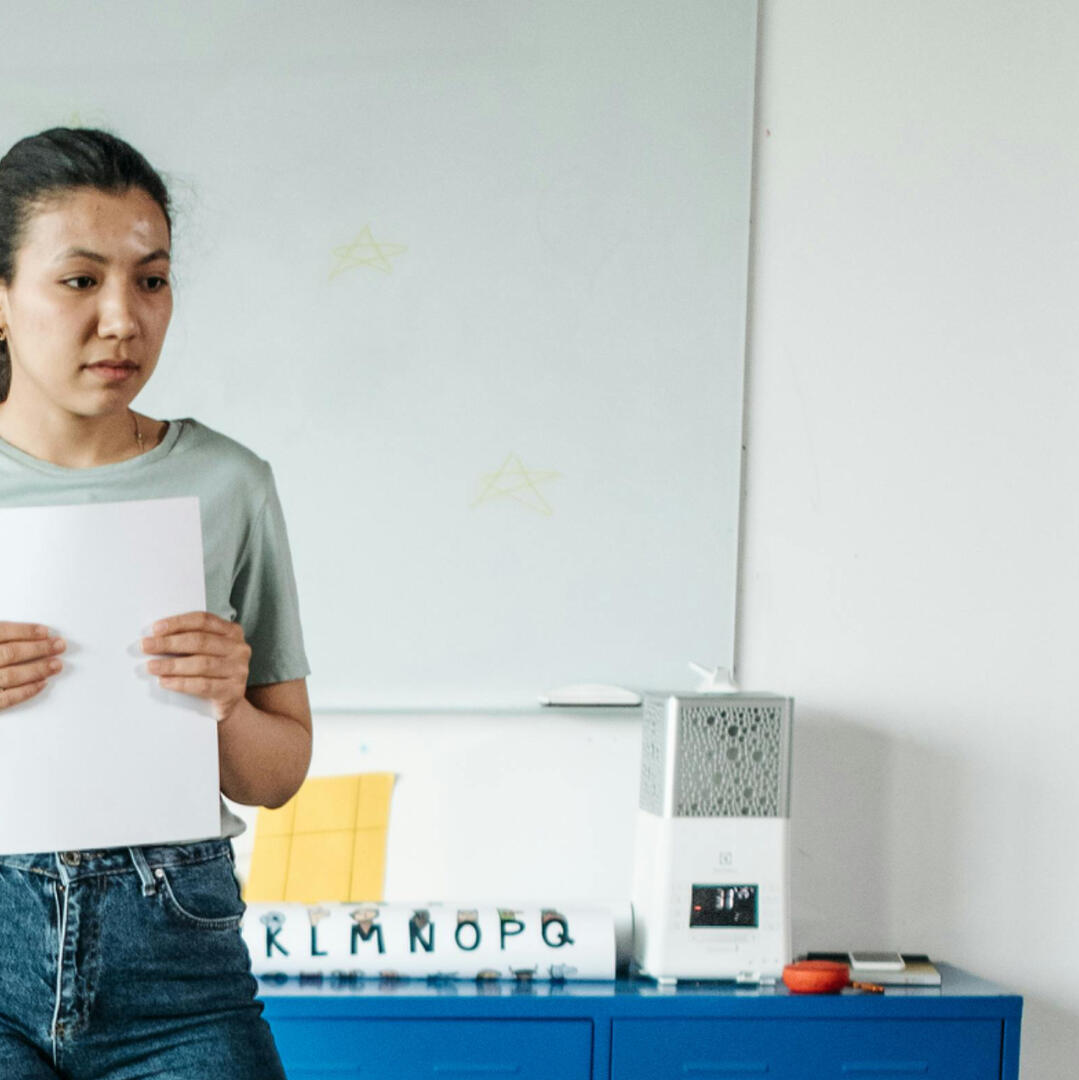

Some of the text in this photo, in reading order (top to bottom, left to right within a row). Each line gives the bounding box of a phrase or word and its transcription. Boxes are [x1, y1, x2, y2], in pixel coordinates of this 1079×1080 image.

[266, 917, 575, 958] K L M N O P Q
